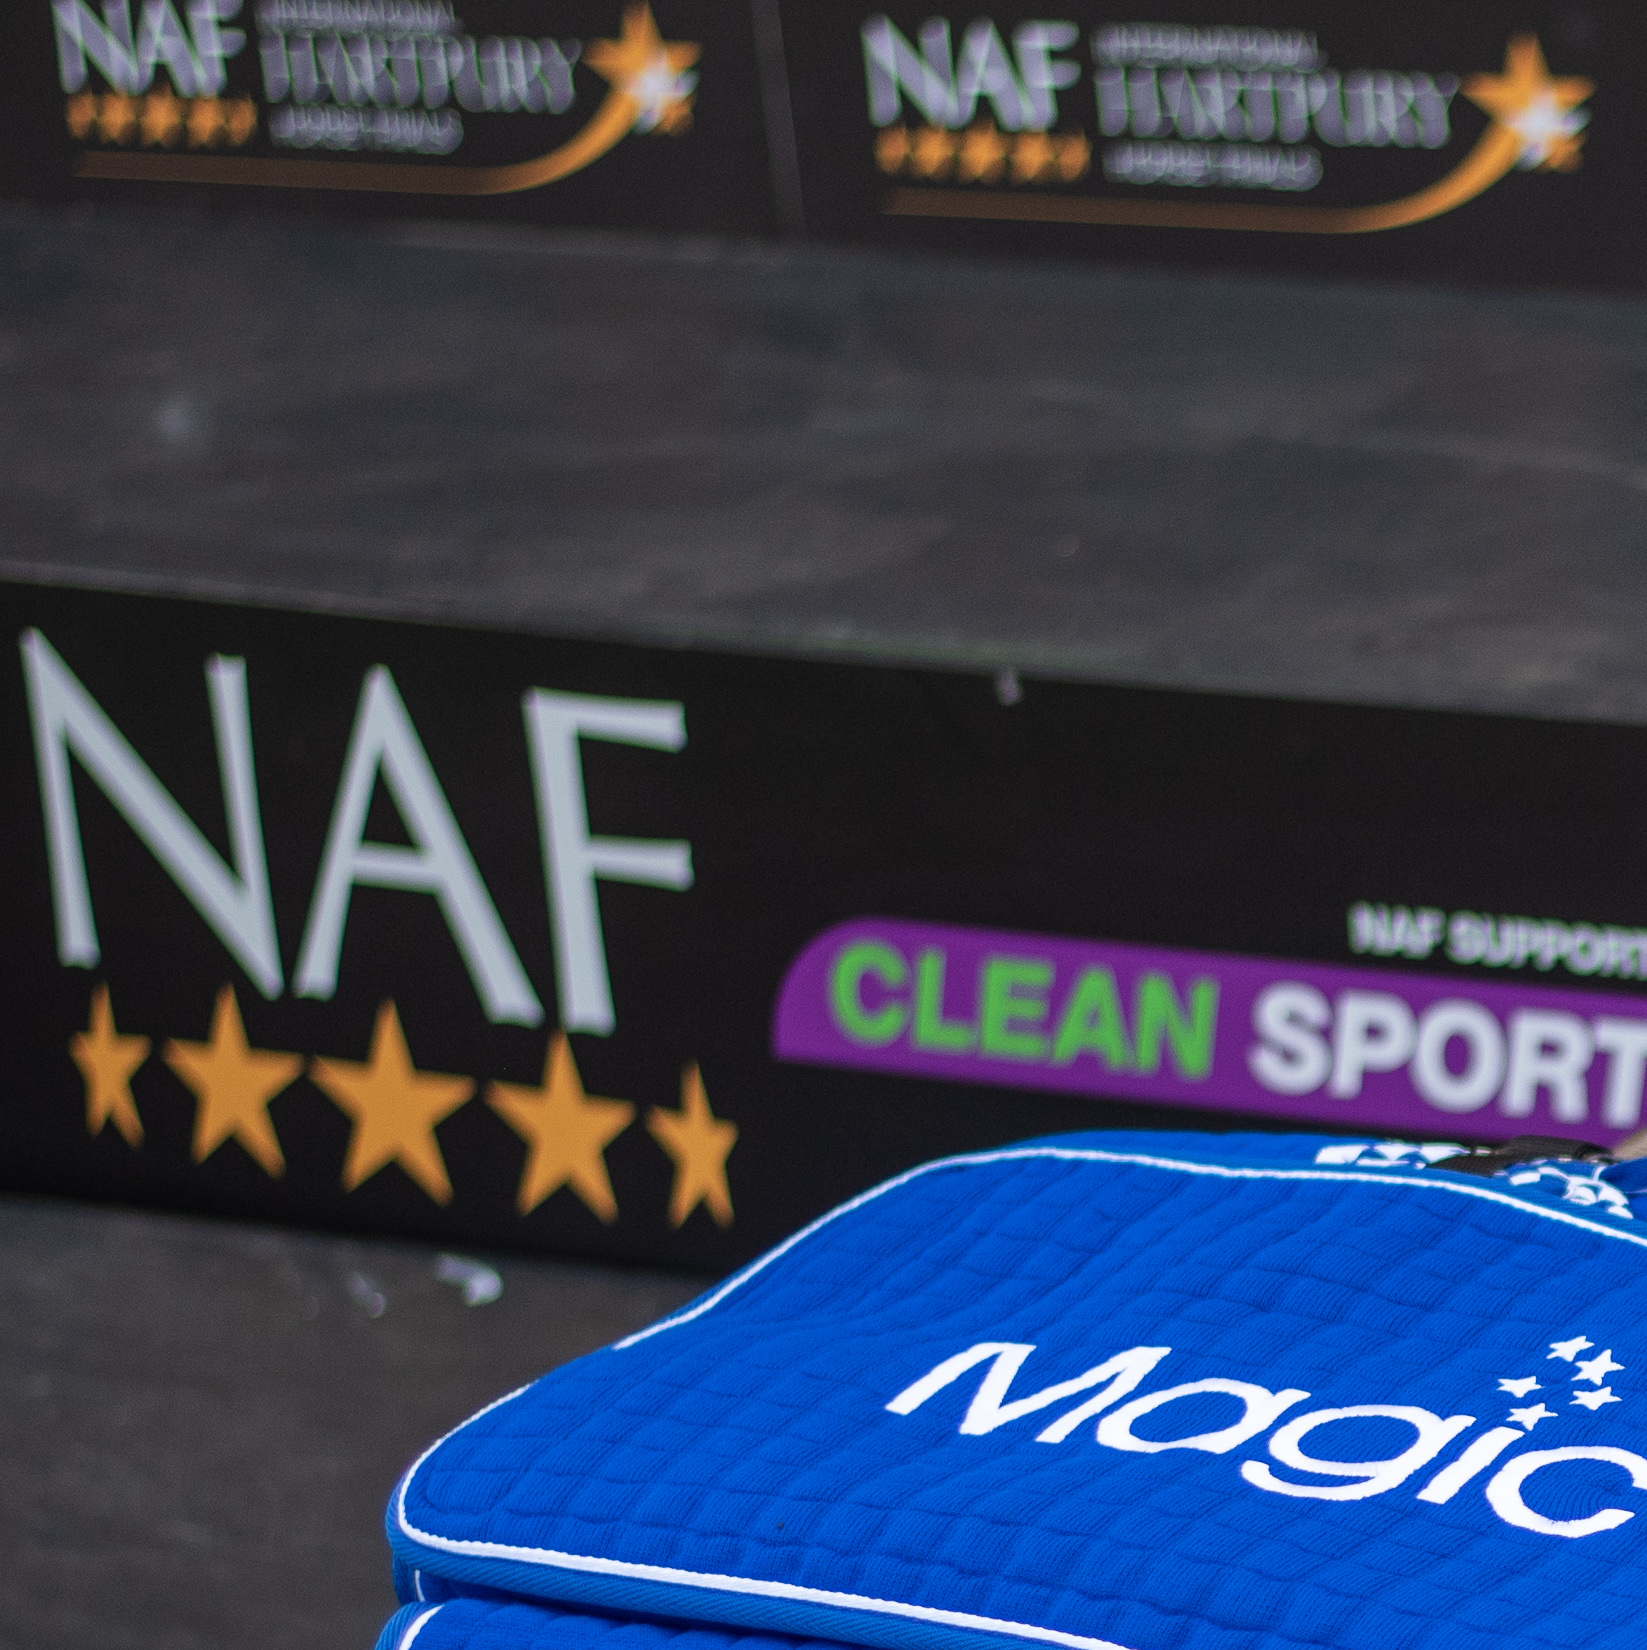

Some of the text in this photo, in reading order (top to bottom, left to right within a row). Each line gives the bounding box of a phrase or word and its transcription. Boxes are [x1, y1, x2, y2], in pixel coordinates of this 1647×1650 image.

[53, 0, 246, 96] NAF
[861, 14, 1080, 132] NAF
[1094, 67, 1460, 149] HARTPURY
[18, 624, 695, 1037] NAF
[1348, 901, 1444, 958] NAF
[829, 939, 1220, 1080] CLEAN
